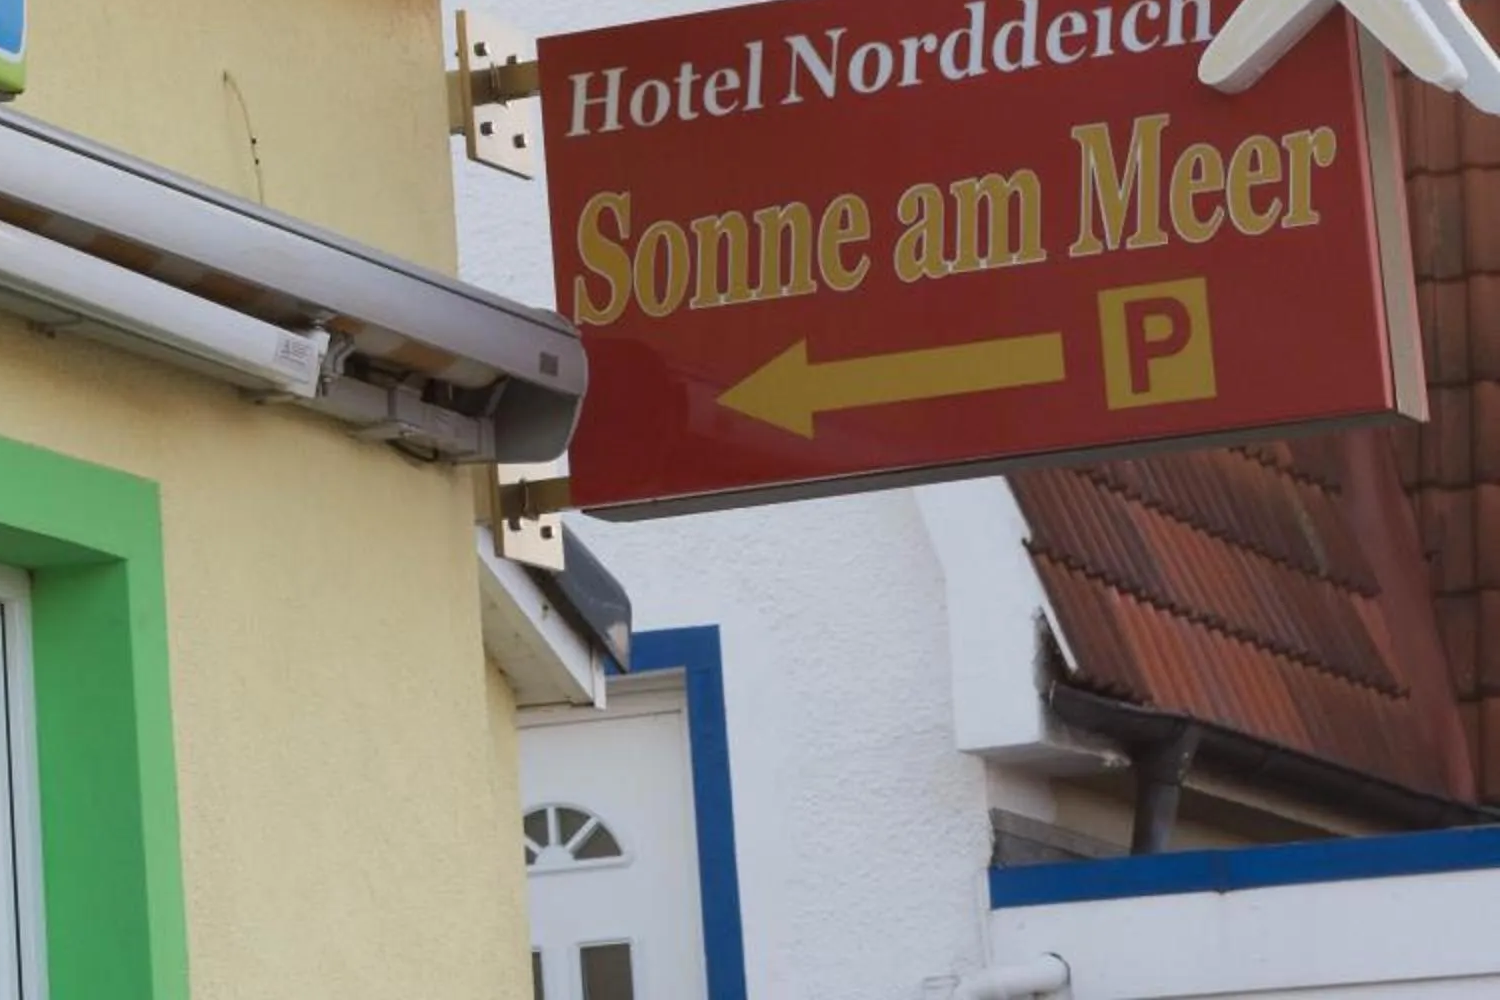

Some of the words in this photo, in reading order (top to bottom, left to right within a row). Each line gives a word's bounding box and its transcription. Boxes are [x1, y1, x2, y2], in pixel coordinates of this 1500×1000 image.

[565, 41, 764, 137] Hotel
[573, 191, 871, 327] Sonne
[893, 167, 1047, 284] am
[1069, 112, 1337, 260] Meer
[1123, 295, 1193, 393] P
